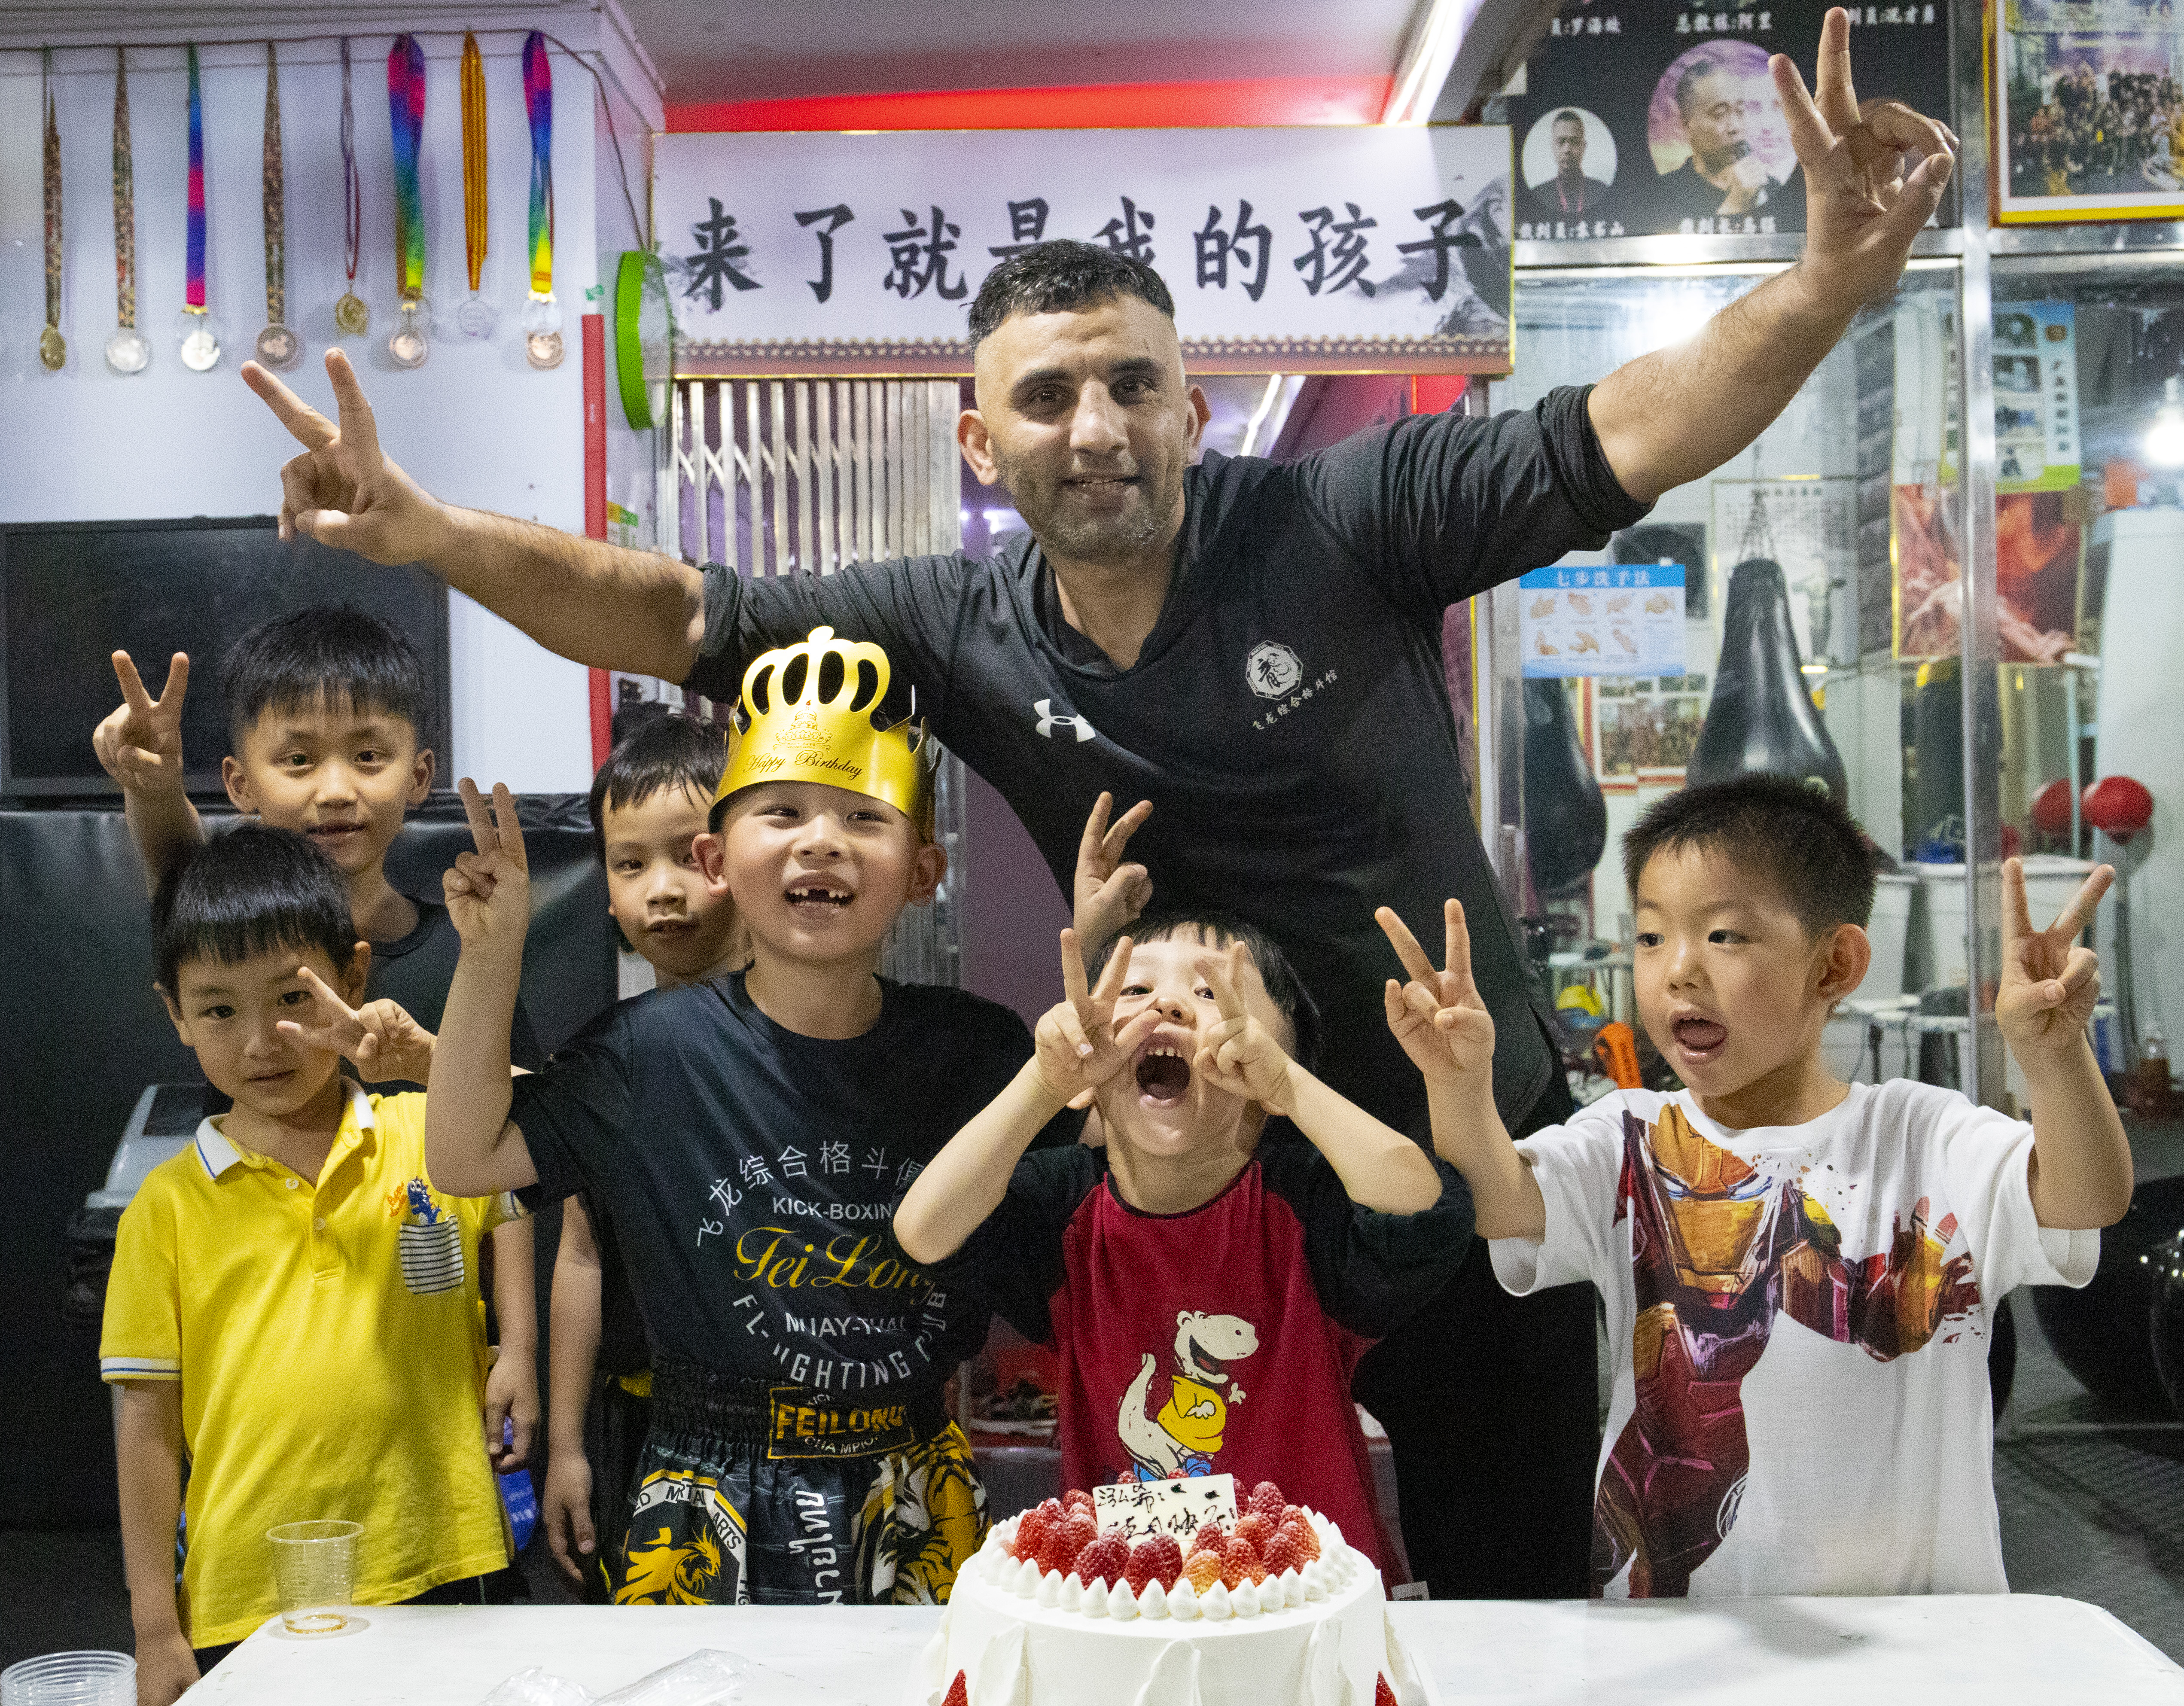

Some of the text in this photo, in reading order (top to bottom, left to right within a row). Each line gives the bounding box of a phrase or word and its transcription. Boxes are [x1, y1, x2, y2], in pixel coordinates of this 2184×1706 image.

[684, 195, 1483, 311] 来了就是我的孩子
[1557, 569, 1650, 587] 七步洗手法
[743, 750, 862, 781] Happy Birthday
[773, 1197, 892, 1220] KICK-BOXIN
[713, 1511, 742, 1550] ARTS
